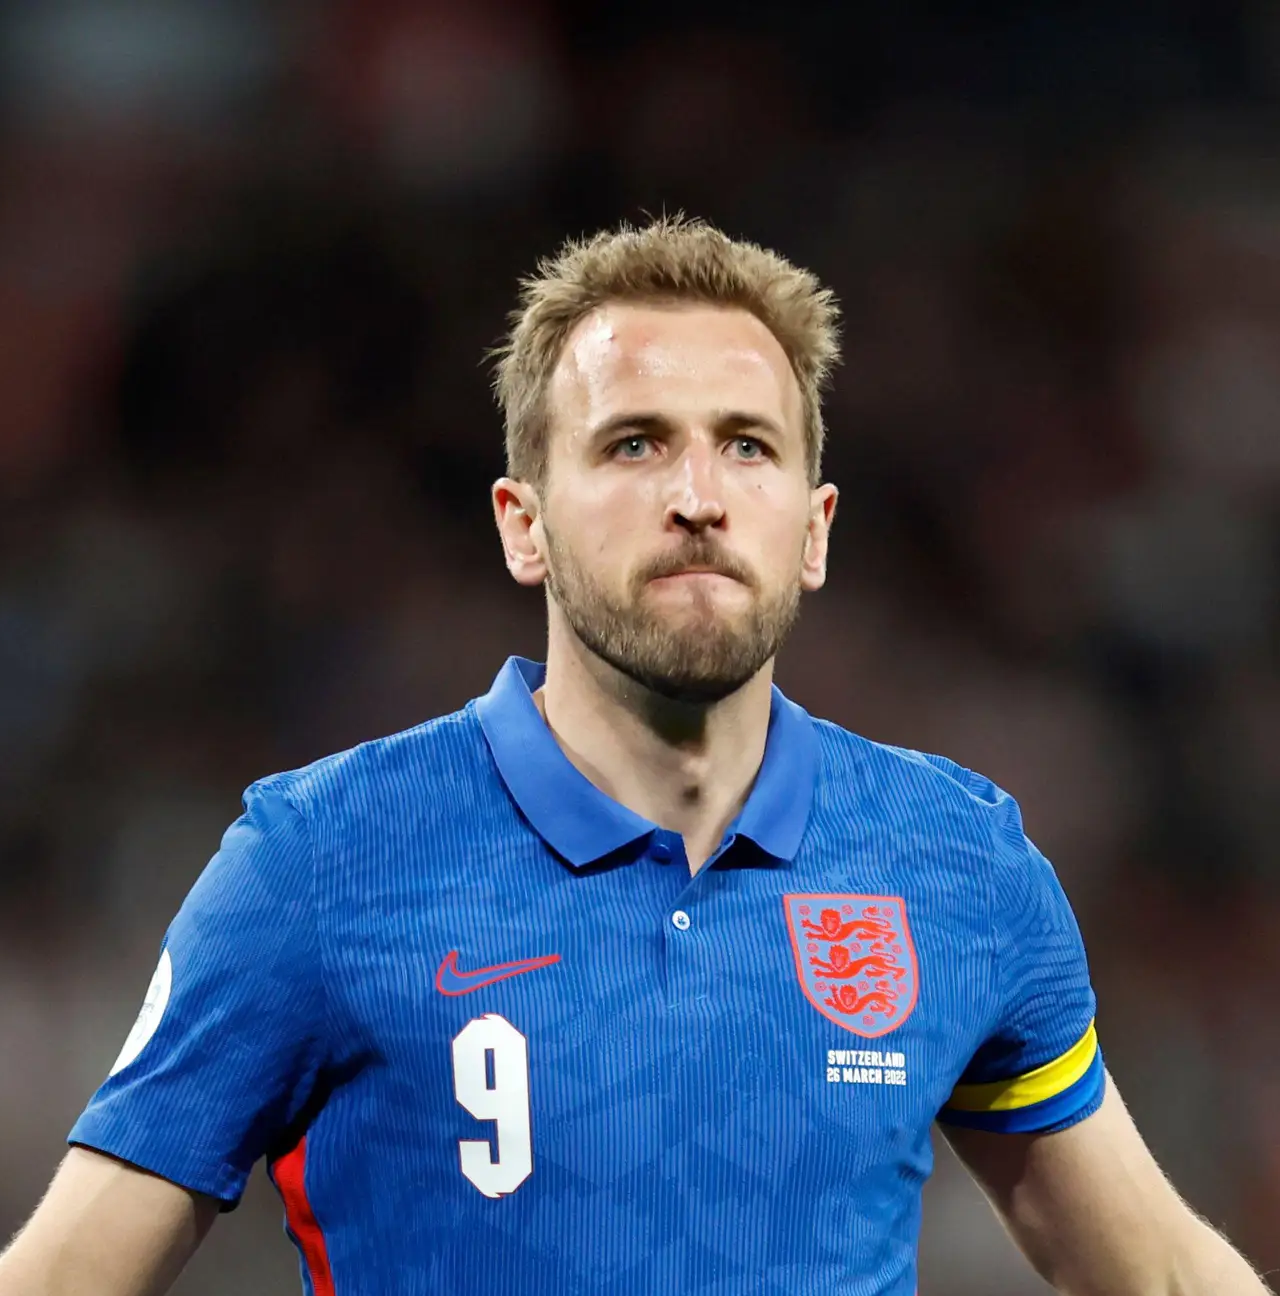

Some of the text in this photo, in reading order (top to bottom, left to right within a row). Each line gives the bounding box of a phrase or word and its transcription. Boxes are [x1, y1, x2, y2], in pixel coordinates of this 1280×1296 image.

[827, 1050, 905, 1067] SWITZERLAND
[827, 1067, 906, 1085] 26 MARCH 2022
[452, 1014, 532, 1198] 9
